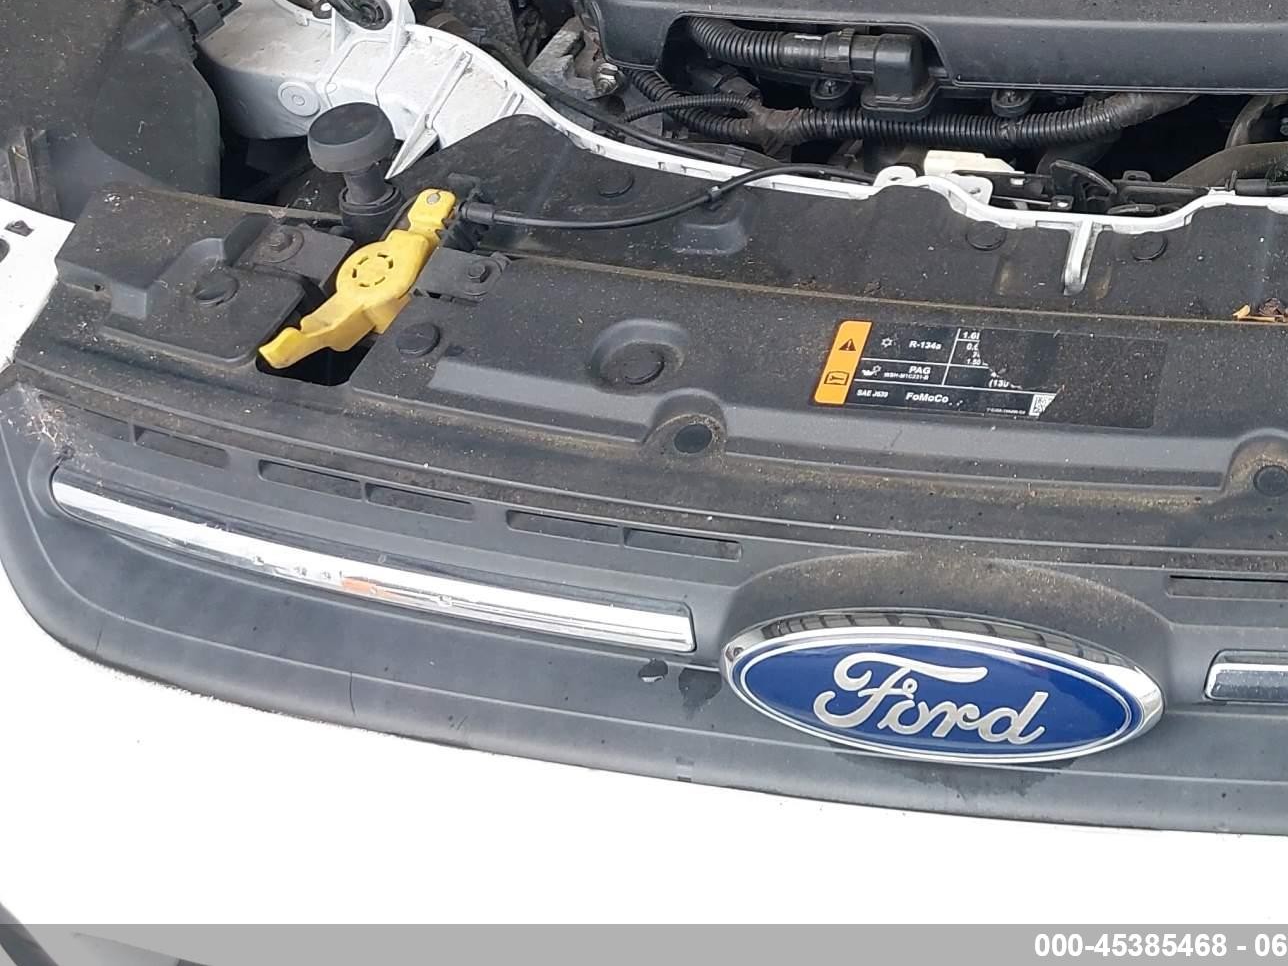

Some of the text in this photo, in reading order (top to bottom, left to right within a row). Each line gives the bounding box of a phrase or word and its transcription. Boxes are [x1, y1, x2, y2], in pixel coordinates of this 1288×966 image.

[909, 340, 942, 351] R-134a
[909, 365, 931, 375] PAG
[857, 388, 872, 397] SAE
[813, 652, 1048, 745] Ford
